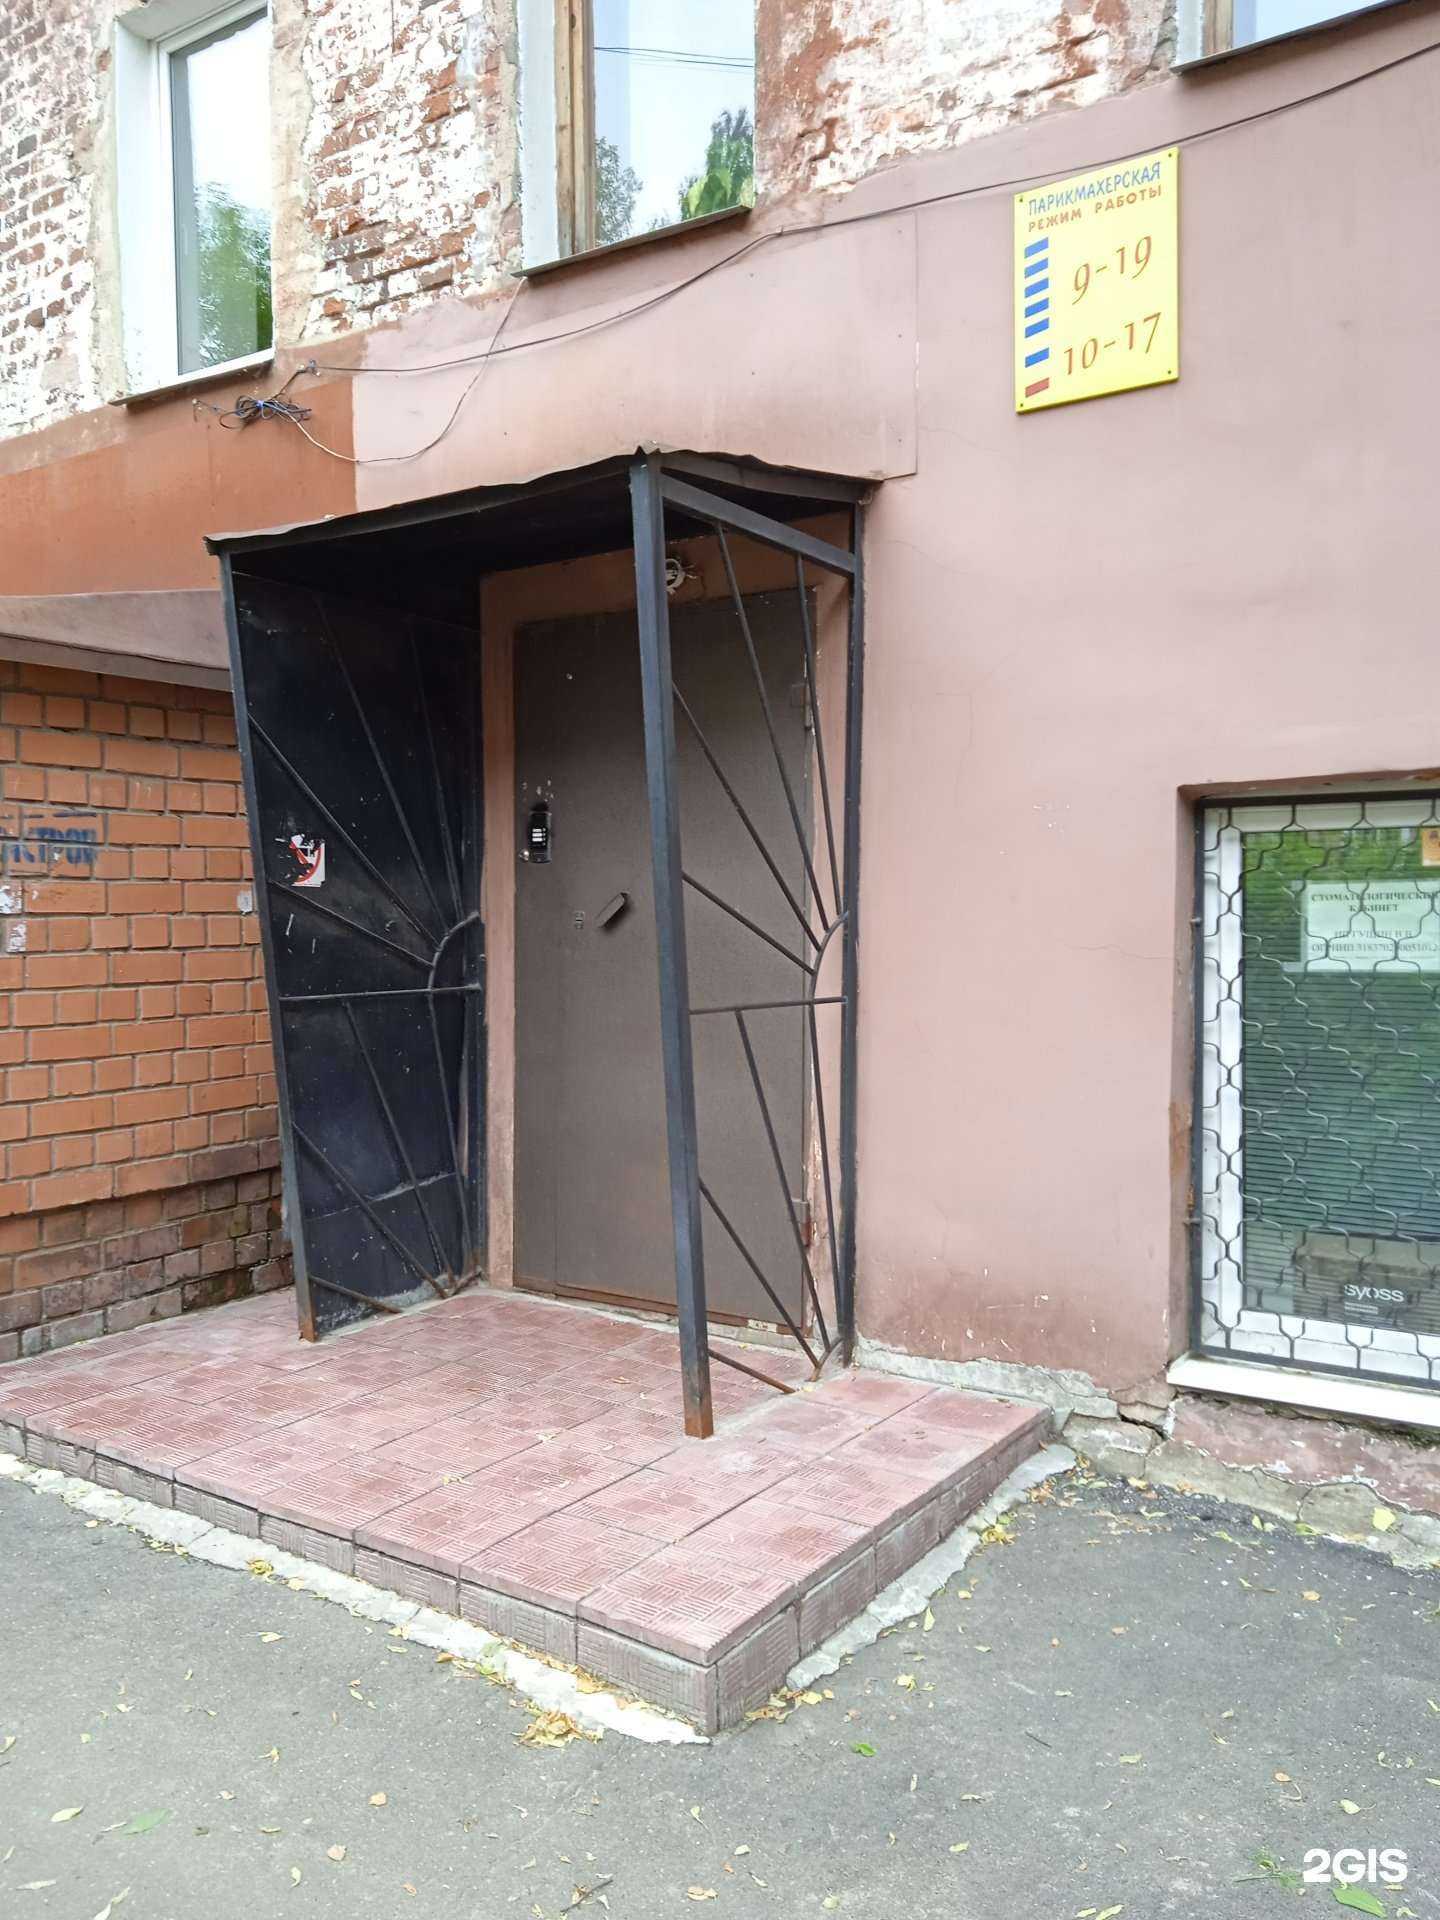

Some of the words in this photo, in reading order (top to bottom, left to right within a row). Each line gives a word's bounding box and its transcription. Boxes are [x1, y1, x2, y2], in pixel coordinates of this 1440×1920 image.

[1028, 161, 1161, 216] ПАРИКМАХЕРСКАЯ
[1028, 208, 1082, 232] РЕЖИМ
[1095, 184, 1162, 213] РАБОТЫ
[1064, 312, 1161, 375] 10-17
[1349, 903, 1399, 912] КБИНЕТ
